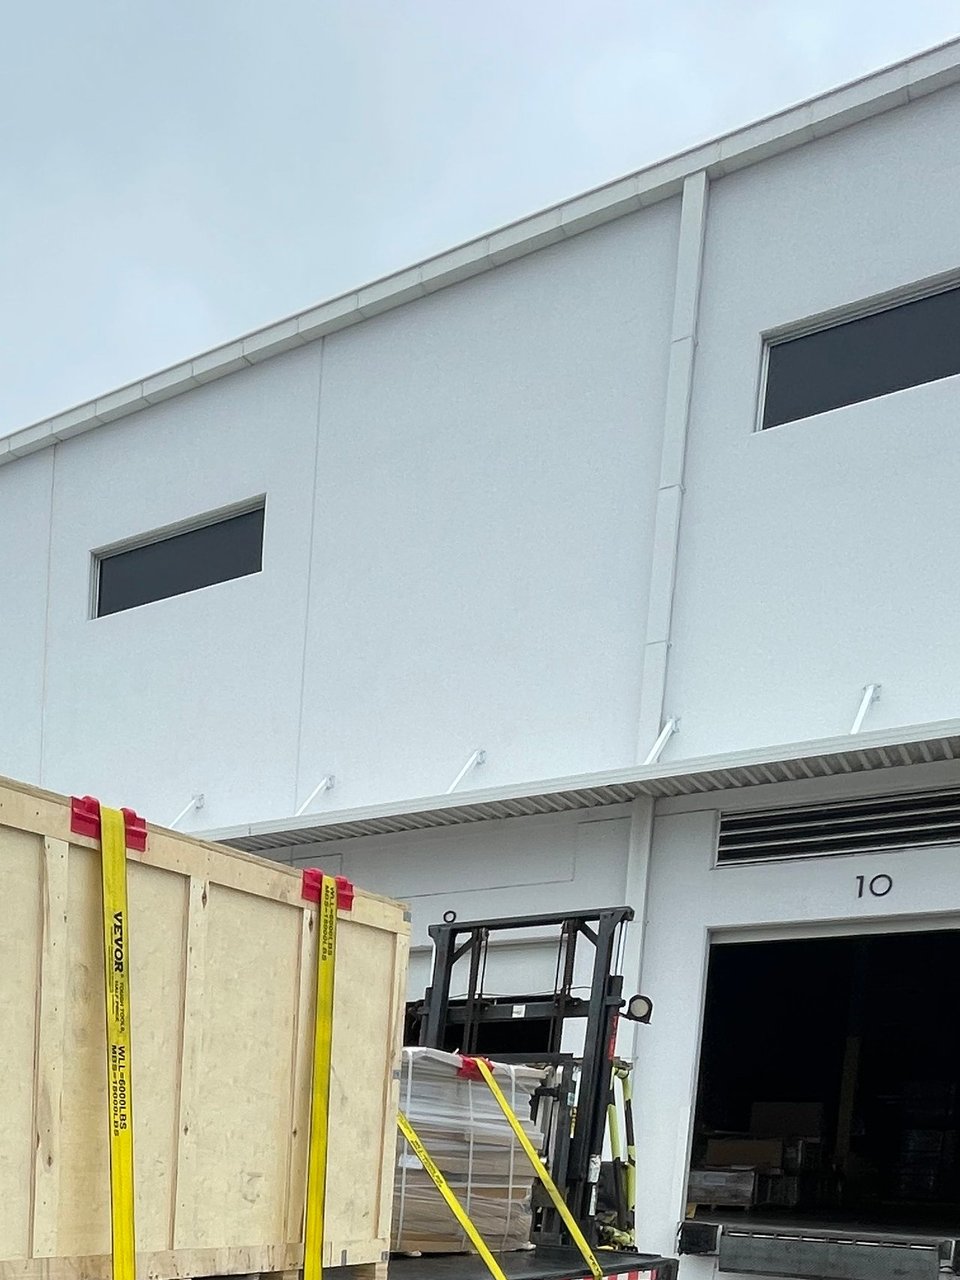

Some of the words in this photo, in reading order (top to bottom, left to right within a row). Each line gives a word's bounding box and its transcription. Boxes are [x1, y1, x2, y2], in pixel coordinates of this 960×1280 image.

[856, 873, 893, 898] 10
[113, 911, 124, 973] VEVOR
[118, 1045, 127, 1130] WLL=6000LBS
